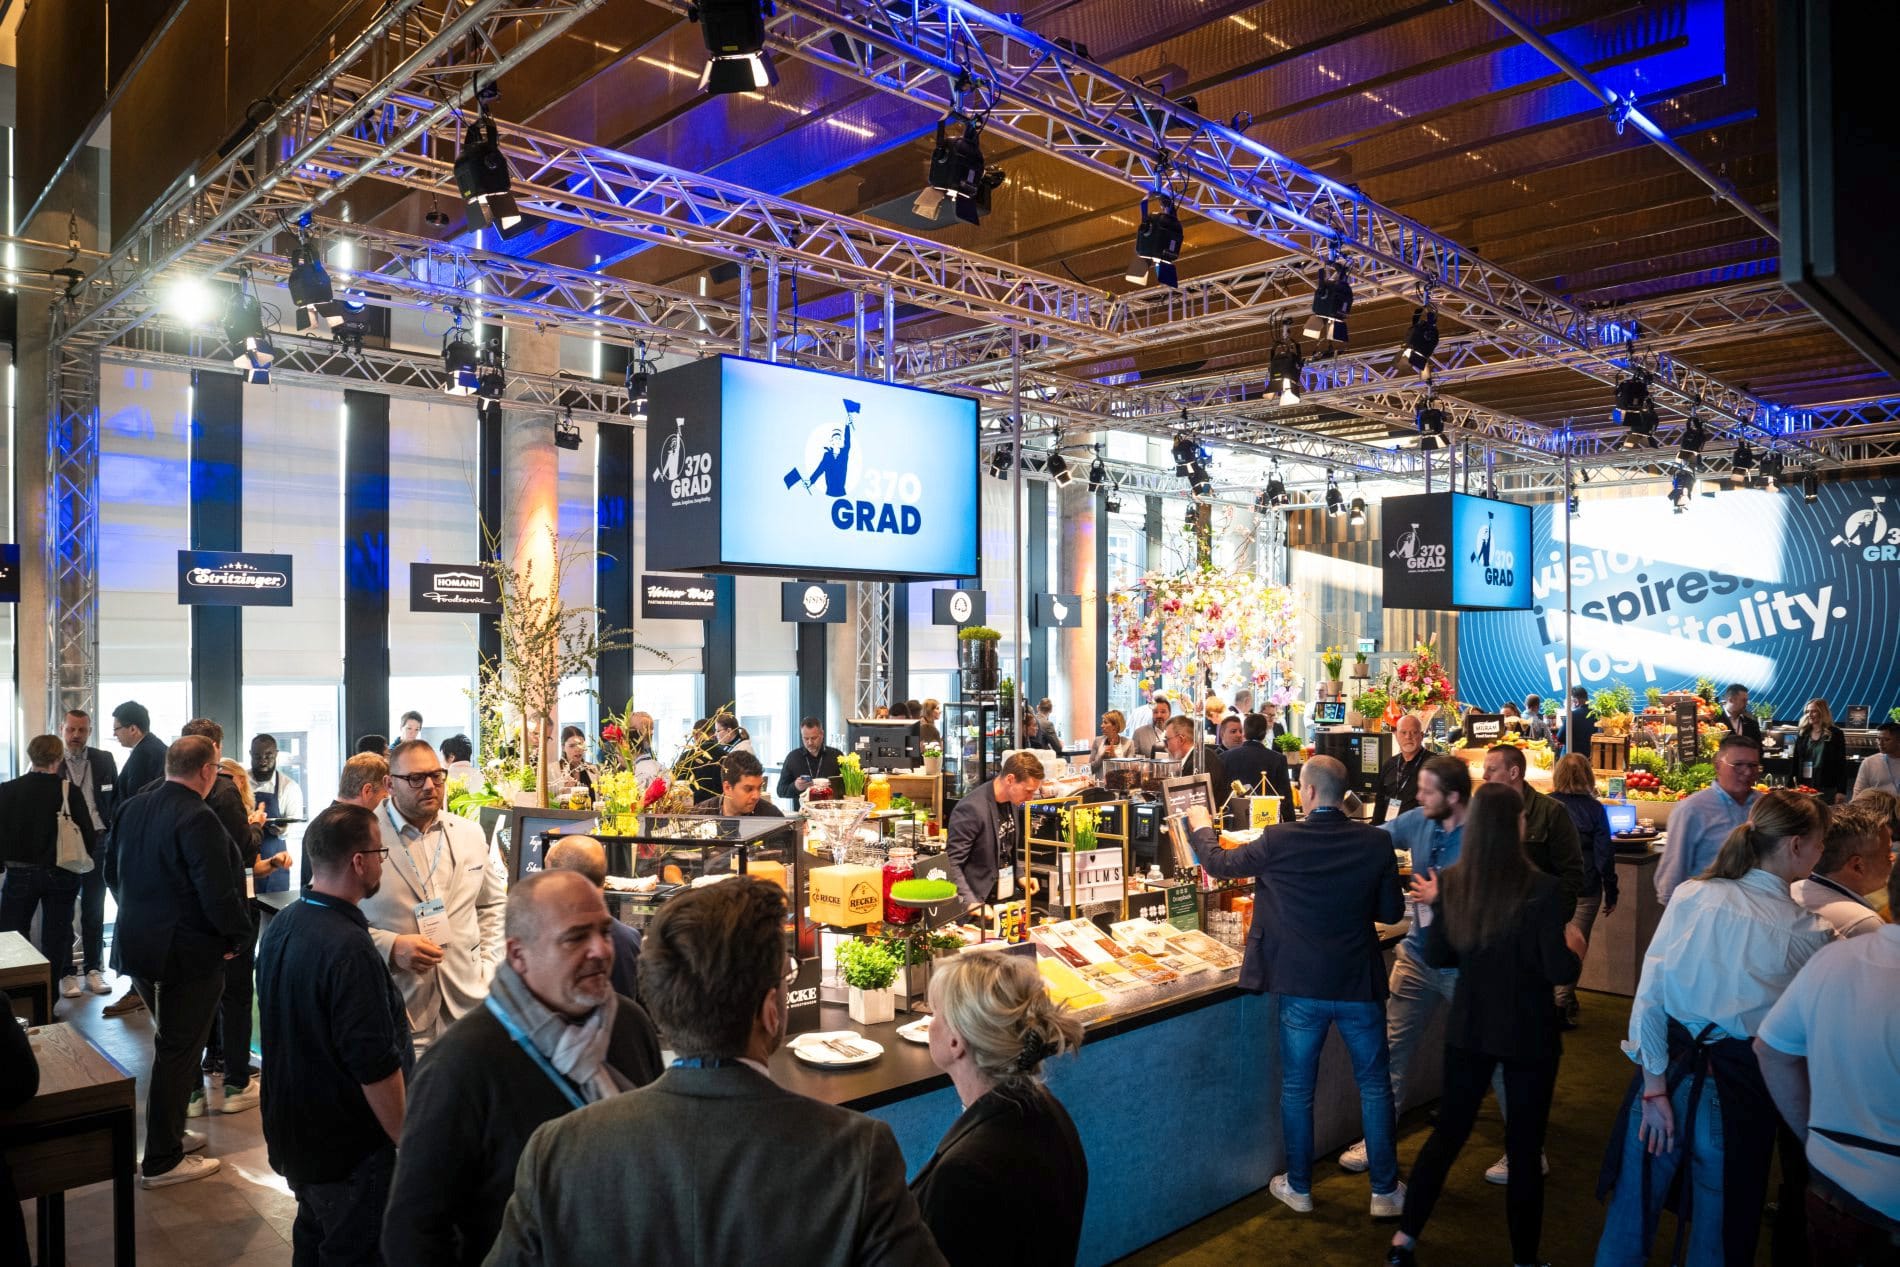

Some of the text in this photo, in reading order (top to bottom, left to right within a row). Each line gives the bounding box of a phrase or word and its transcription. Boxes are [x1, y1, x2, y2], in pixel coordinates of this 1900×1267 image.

[685, 452, 712, 477] 370
[670, 474, 712, 499] GRAD
[863, 467, 923, 504] 370
[831, 498, 922, 535] GRAD
[1420, 544, 1446, 557] 370
[1494, 549, 1514, 569] 370
[1863, 545, 1900, 562] GR
[1406, 556, 1446, 569] GRAD
[437, 578, 480, 588] HOMANN
[1485, 567, 1514, 587] GRAD
[423, 591, 492, 604] Foodservice
[1533, 570, 1755, 646] ispires.
